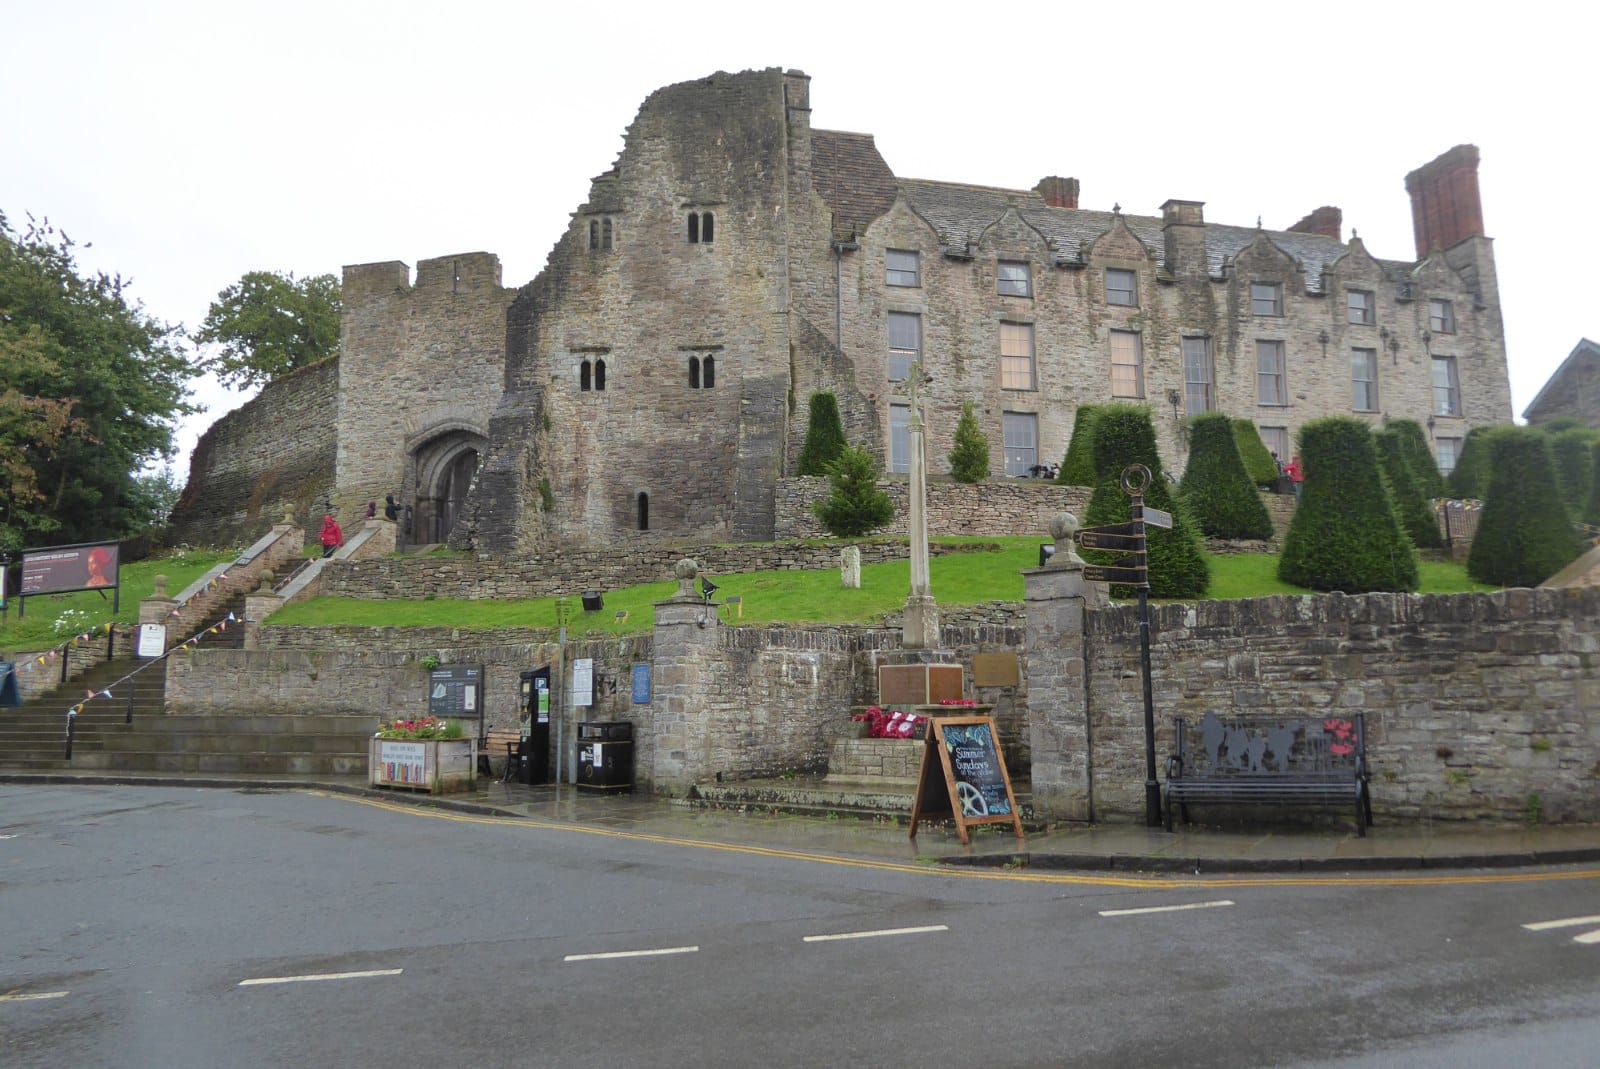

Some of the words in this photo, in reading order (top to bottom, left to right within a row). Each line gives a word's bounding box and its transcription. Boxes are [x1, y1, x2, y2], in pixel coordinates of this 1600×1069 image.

[538, 679, 545, 688] P
[956, 747, 985, 759] Summer
[955, 759, 989, 770] Sundays
